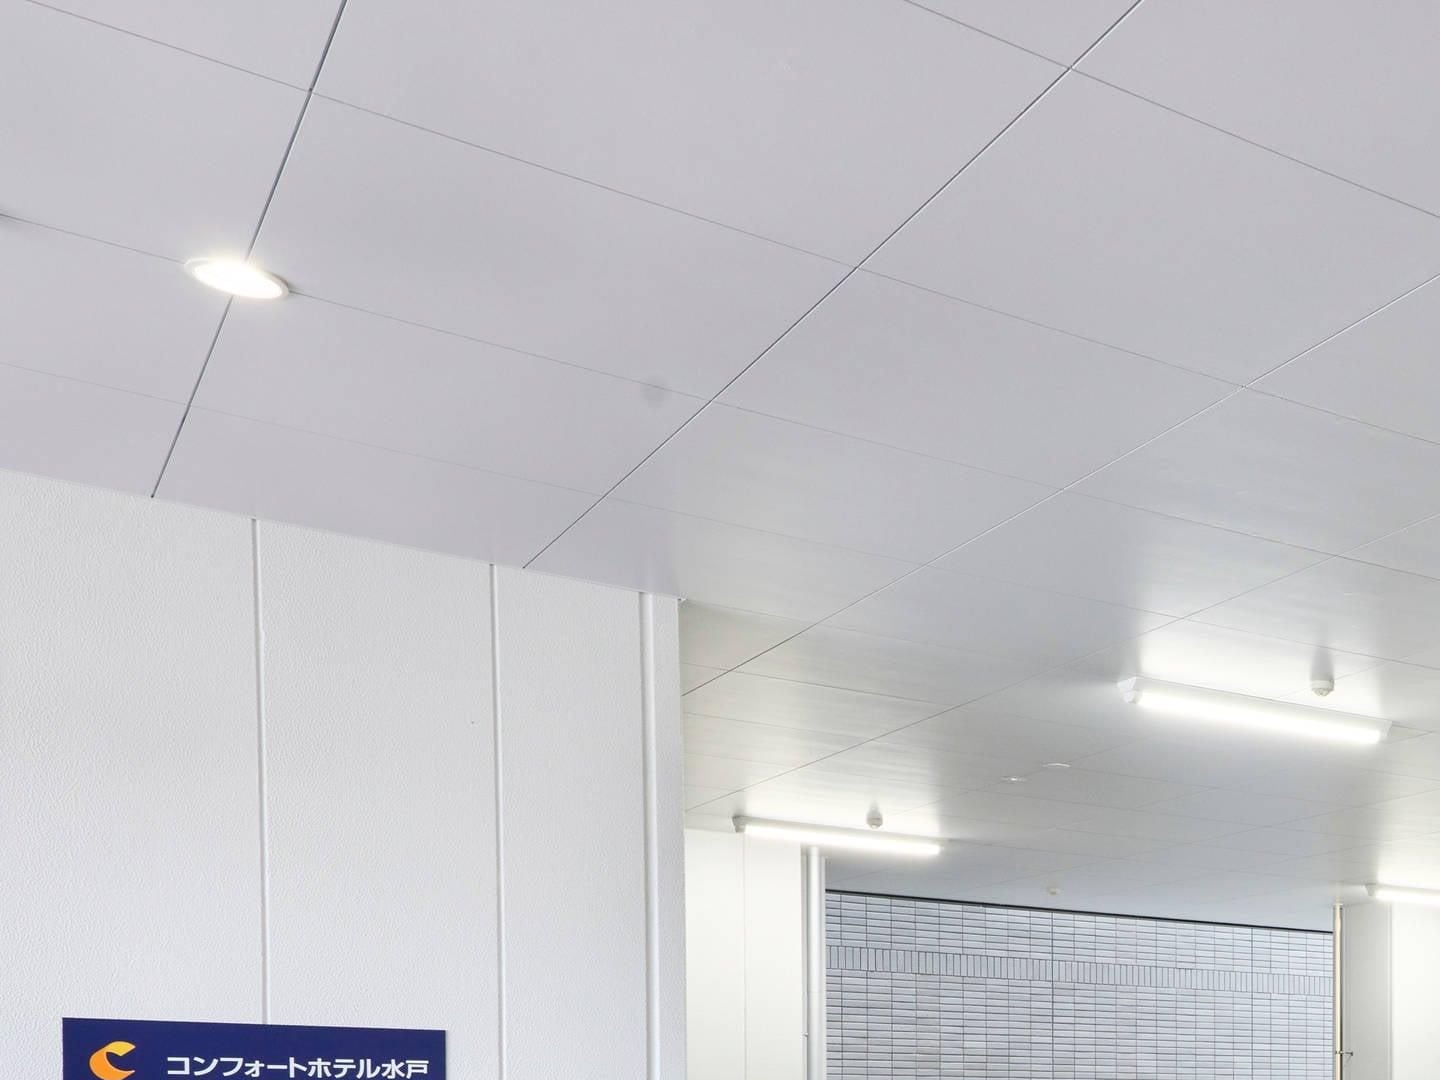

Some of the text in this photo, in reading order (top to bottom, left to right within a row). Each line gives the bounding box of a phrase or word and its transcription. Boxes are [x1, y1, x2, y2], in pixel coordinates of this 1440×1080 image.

[167, 1056, 430, 1080] コンフォートホテル水戸
